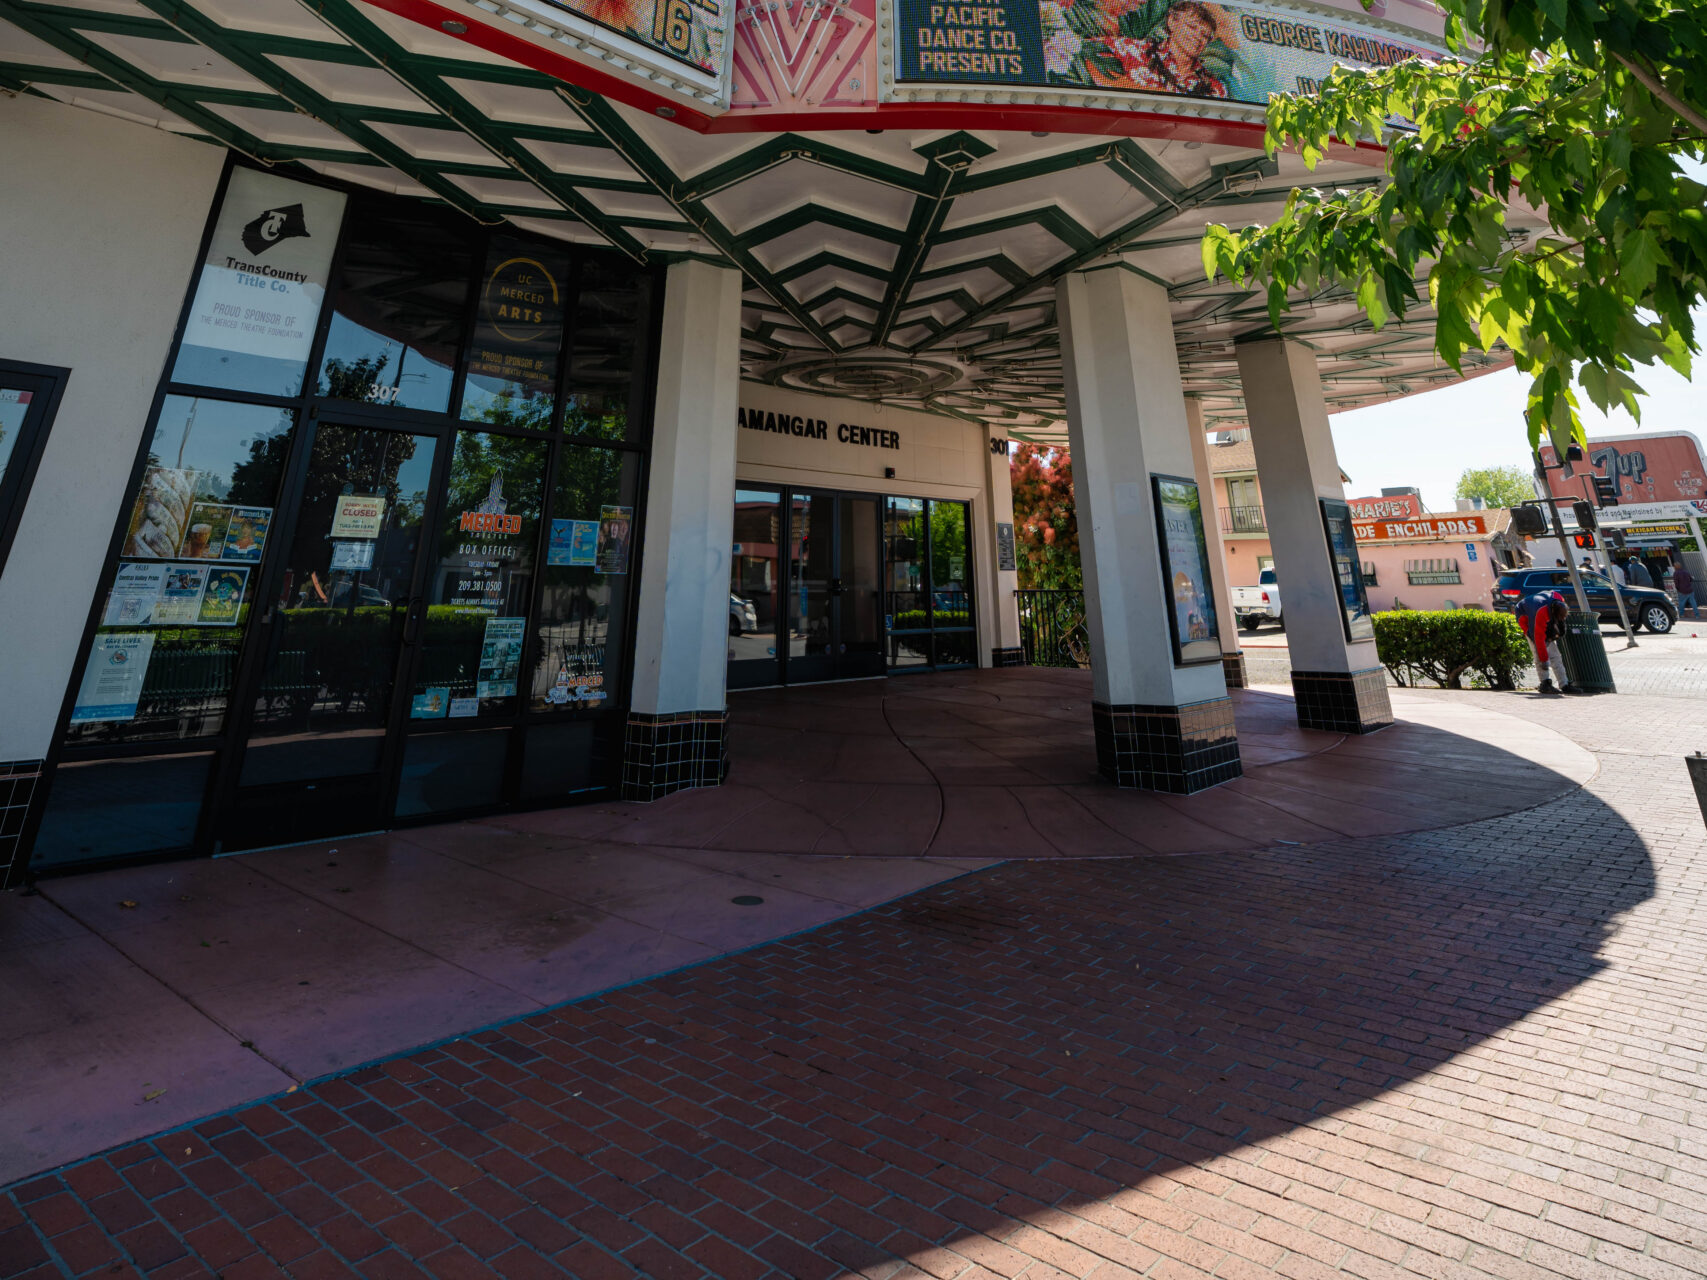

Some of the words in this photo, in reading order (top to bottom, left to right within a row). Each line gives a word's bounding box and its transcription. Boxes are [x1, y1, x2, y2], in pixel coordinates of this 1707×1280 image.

[930, 6, 1005, 26] PACIFIC
[918, 28, 985, 49] DANCE
[990, 30, 1021, 51] CO.
[1240, 14, 1325, 53] GEORGE
[920, 52, 1022, 75] PRESENTS
[226, 256, 308, 285] TransCounty
[518, 273, 533, 286] UC
[236, 273, 266, 289] Title
[270, 280, 290, 294] Co.
[500, 286, 544, 305] MERCED
[213, 302, 241, 318] PROUD
[244, 308, 281, 326] SPONSOR
[285, 315, 297, 328] OF
[497, 304, 543, 323] ARTS
[481, 350, 503, 363] PROUD
[368, 383, 400, 402] 307
[737, 407, 827, 440] AMANGAR
[837, 423, 900, 450] CENTER
[990, 437, 1010, 456] 301
[342, 508, 378, 518] CLOSED
[1350, 500, 1412, 519] MARIE'S
[459, 511, 522, 535] MERCED
[1386, 520, 1478, 538] ENCHILADAS
[458, 544, 478, 555] BOX
[482, 545, 513, 557] OFFICE
[458, 581, 502, 591] 209.381.0500
[568, 675, 604, 688] MERCED
